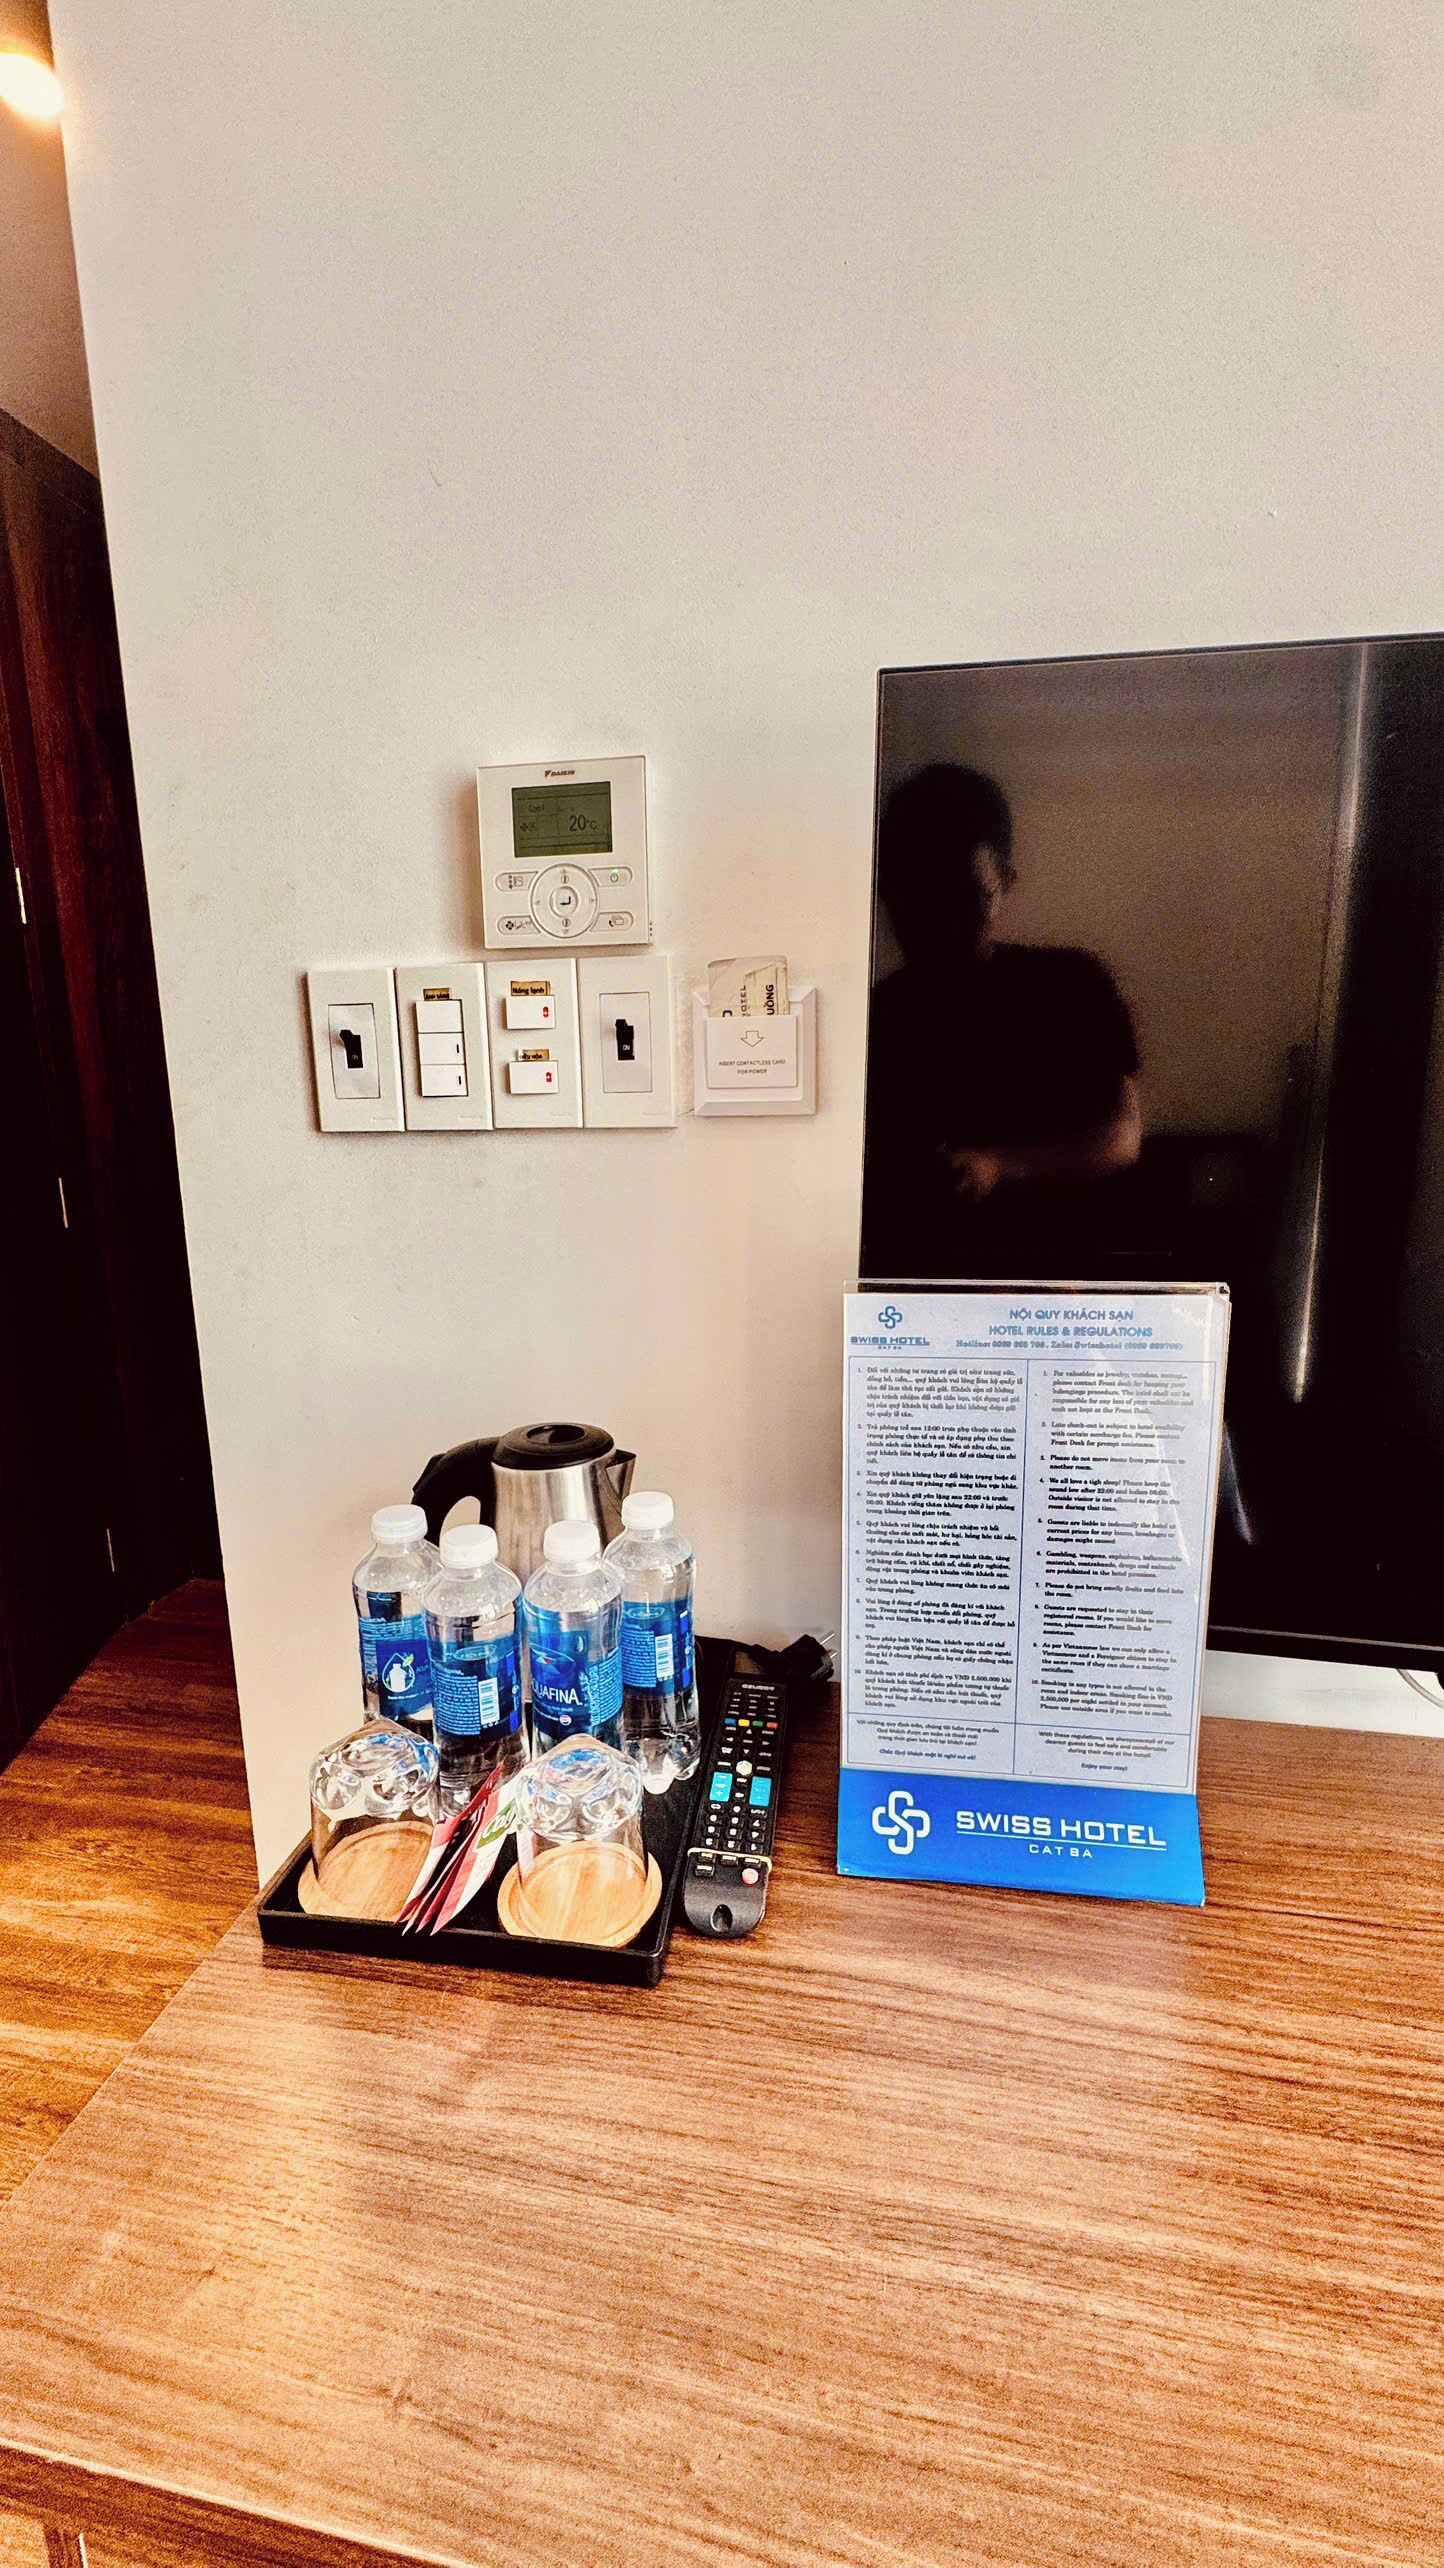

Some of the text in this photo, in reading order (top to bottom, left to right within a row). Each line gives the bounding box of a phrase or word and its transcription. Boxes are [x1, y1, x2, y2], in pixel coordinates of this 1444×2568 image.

[1010, 1308, 1134, 1322] NỘI QUY KHÁCH SẠN
[989, 1326, 1153, 1337] HOTEL RULES & REGULATIONS
[956, 1810, 1166, 1846] SWISS HOTEL
[1029, 1844, 1092, 1858] CAT BA
